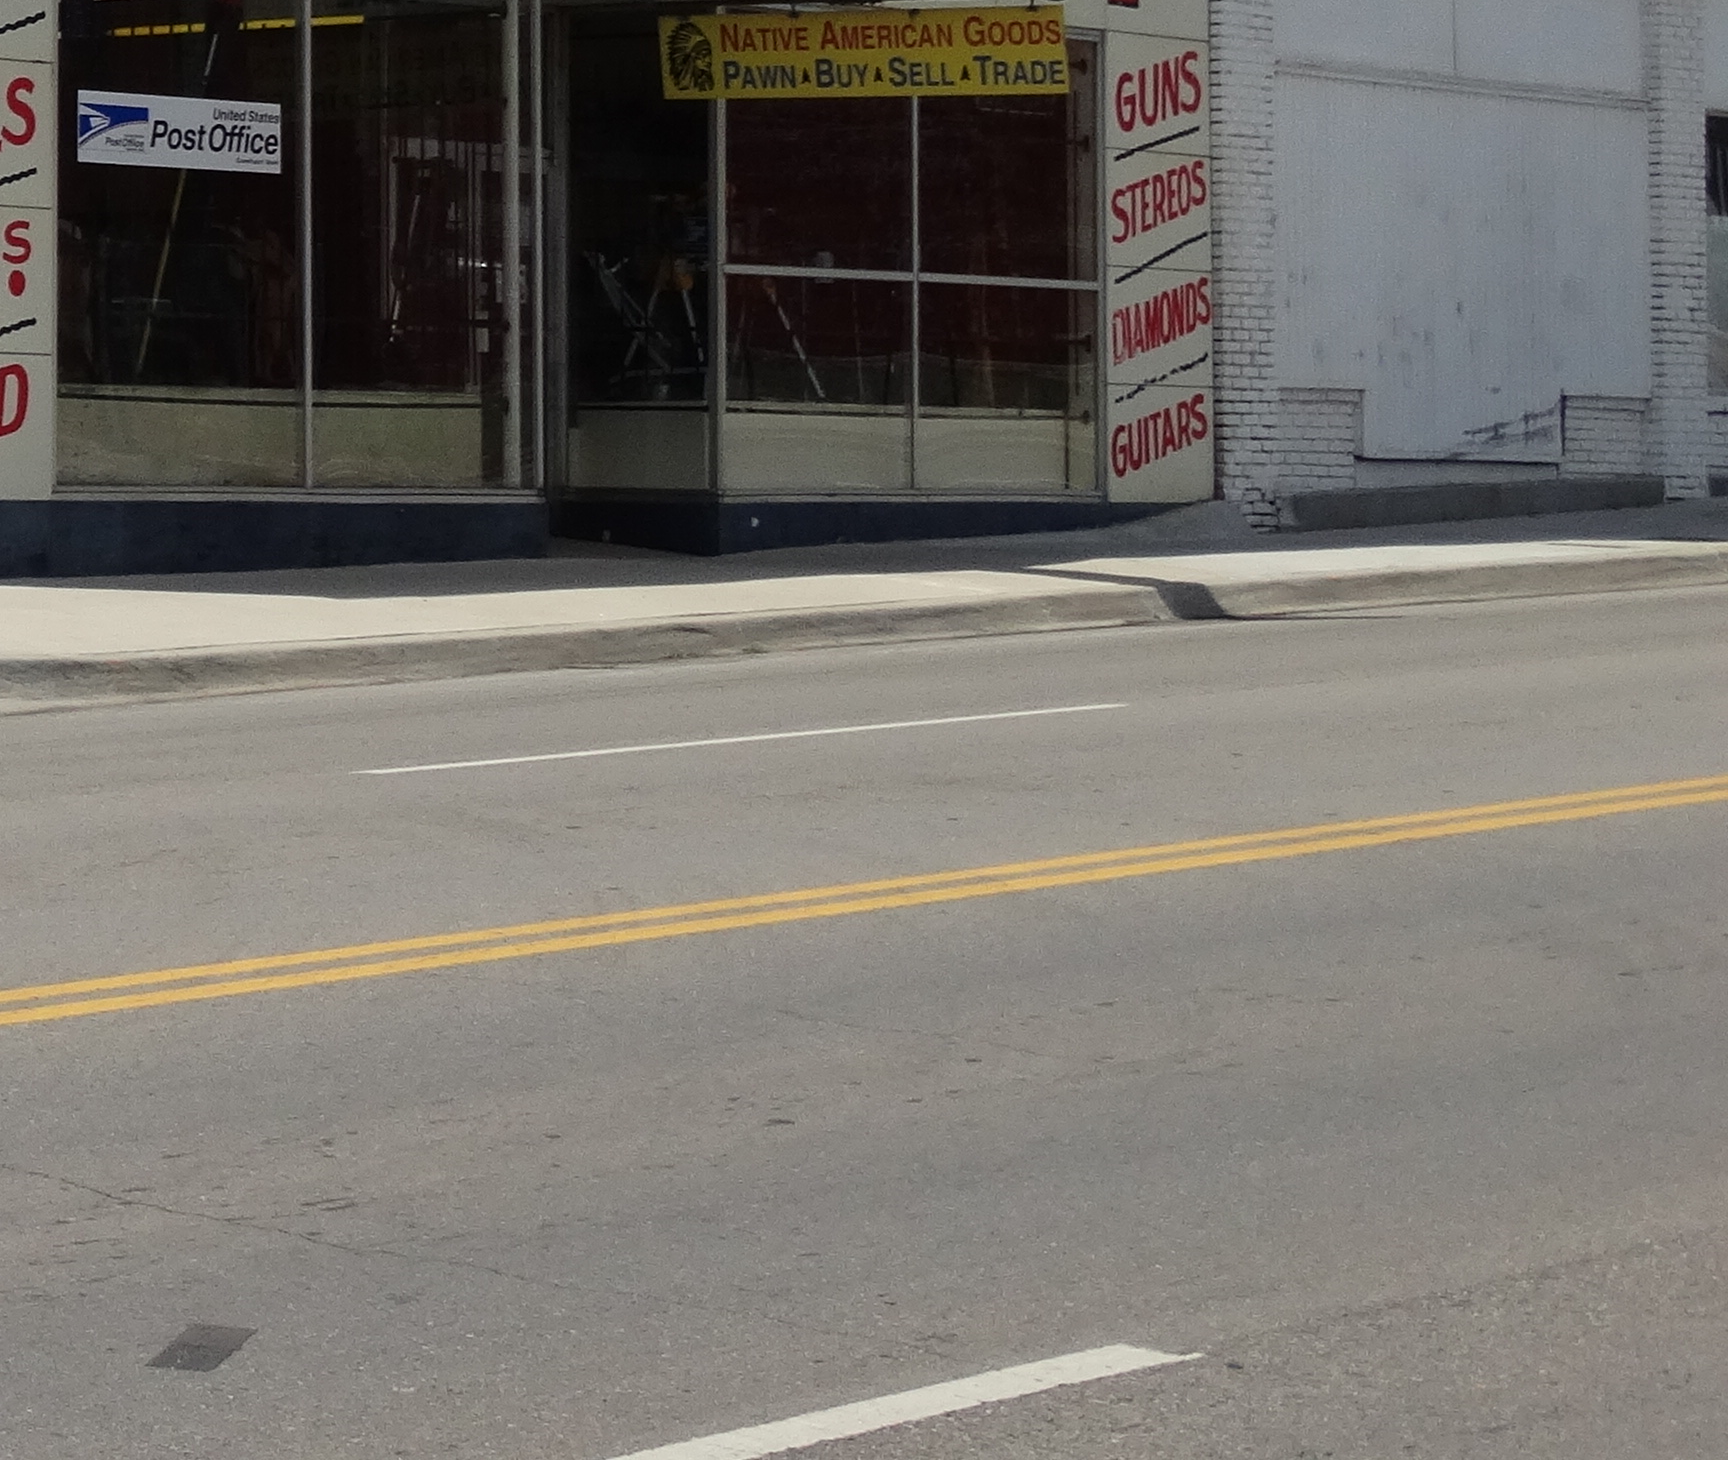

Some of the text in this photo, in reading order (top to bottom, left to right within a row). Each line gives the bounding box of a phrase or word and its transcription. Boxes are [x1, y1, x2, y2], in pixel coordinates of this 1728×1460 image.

[213, 108, 279, 124] United States
[1114, 50, 1202, 132] GUNS
[150, 120, 278, 155] Post Office
[1110, 159, 1207, 244] STEREOS
[1112, 276, 1211, 367] DIAMONDS
[1111, 393, 1208, 478] GUITARS
